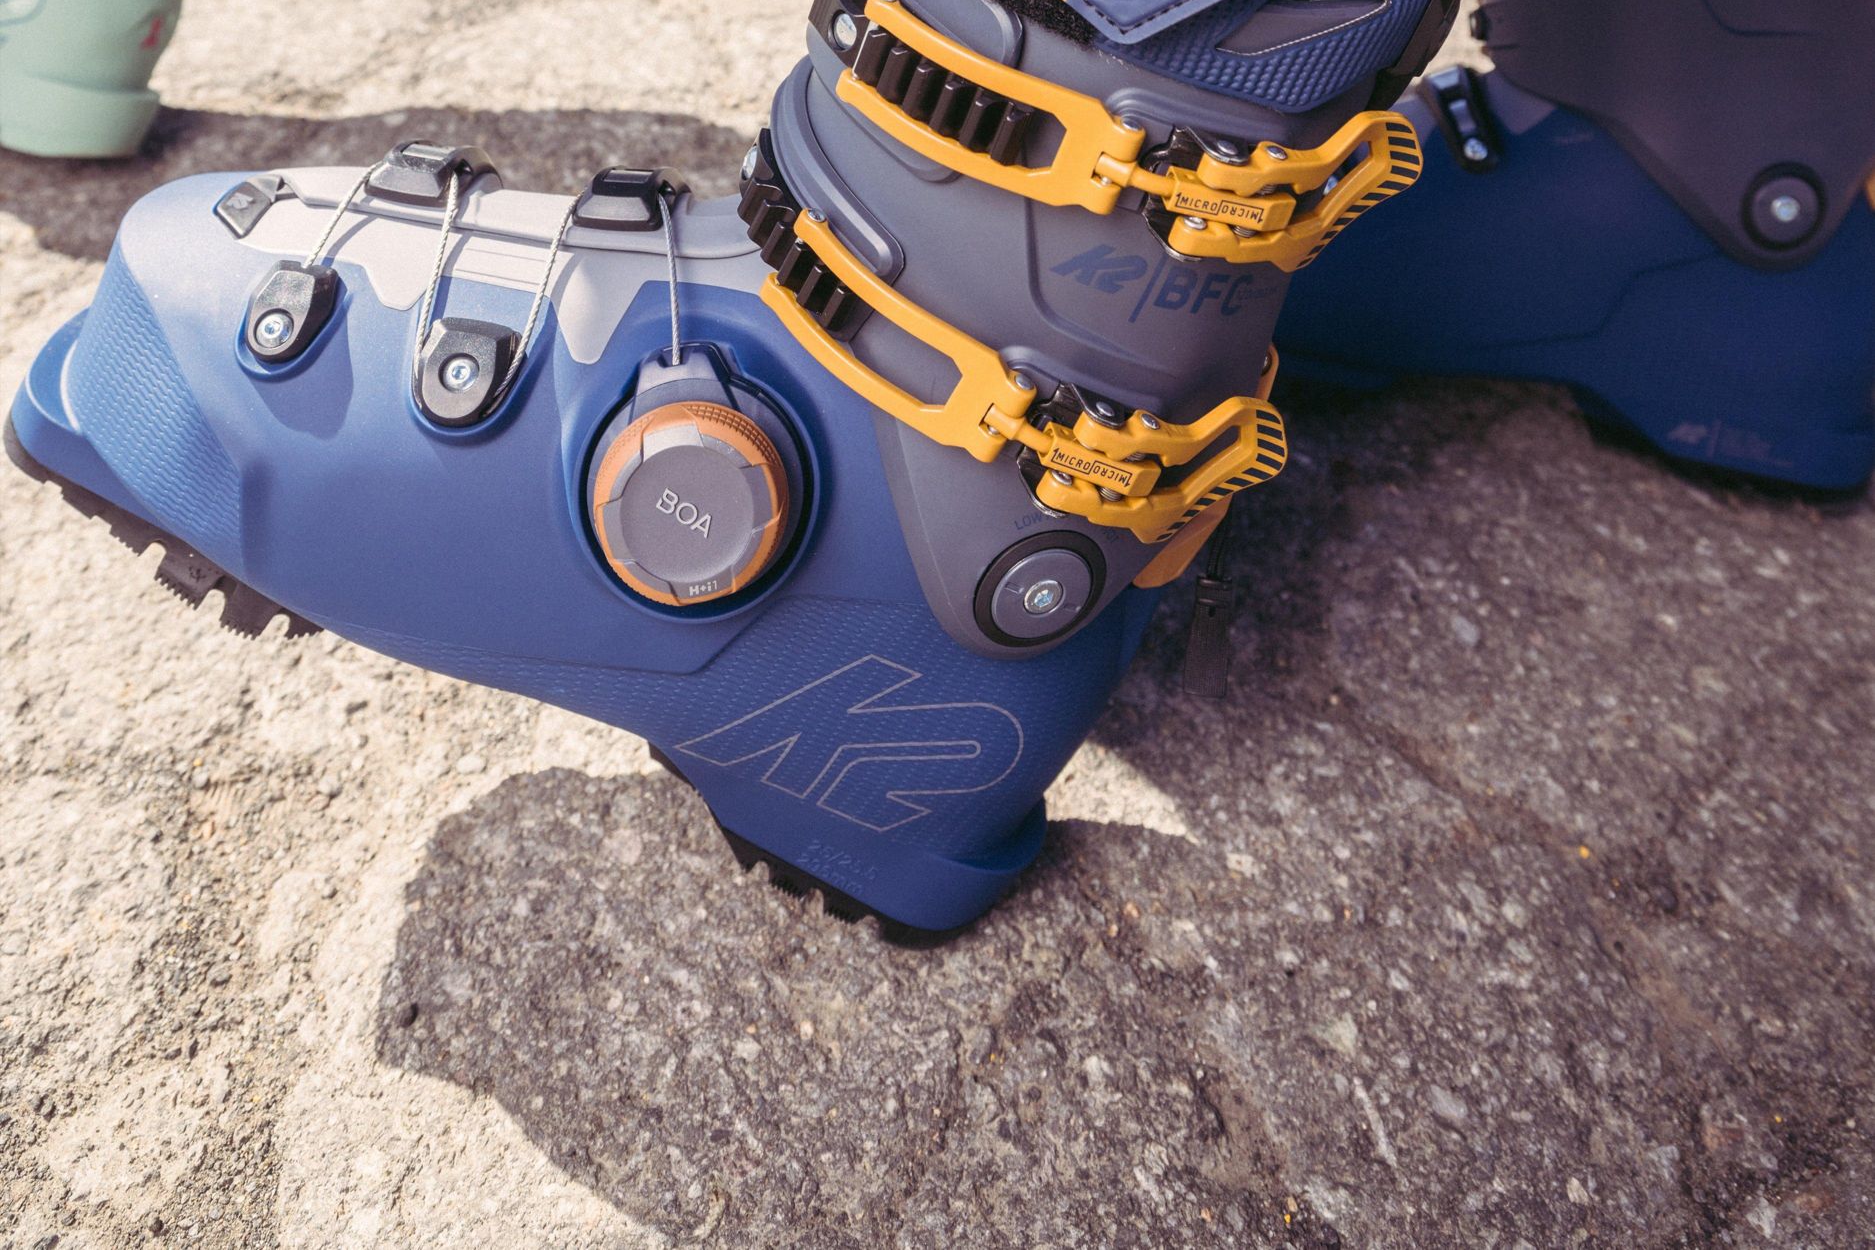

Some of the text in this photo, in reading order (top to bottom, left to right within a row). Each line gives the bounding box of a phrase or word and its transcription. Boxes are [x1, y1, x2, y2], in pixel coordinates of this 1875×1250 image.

[1179, 195, 1218, 213] MICRO
[1050, 244, 1253, 316] K2 BFC
[1056, 452, 1091, 470] MICRO
[656, 488, 712, 538] BOA
[673, 654, 1024, 832] K2
